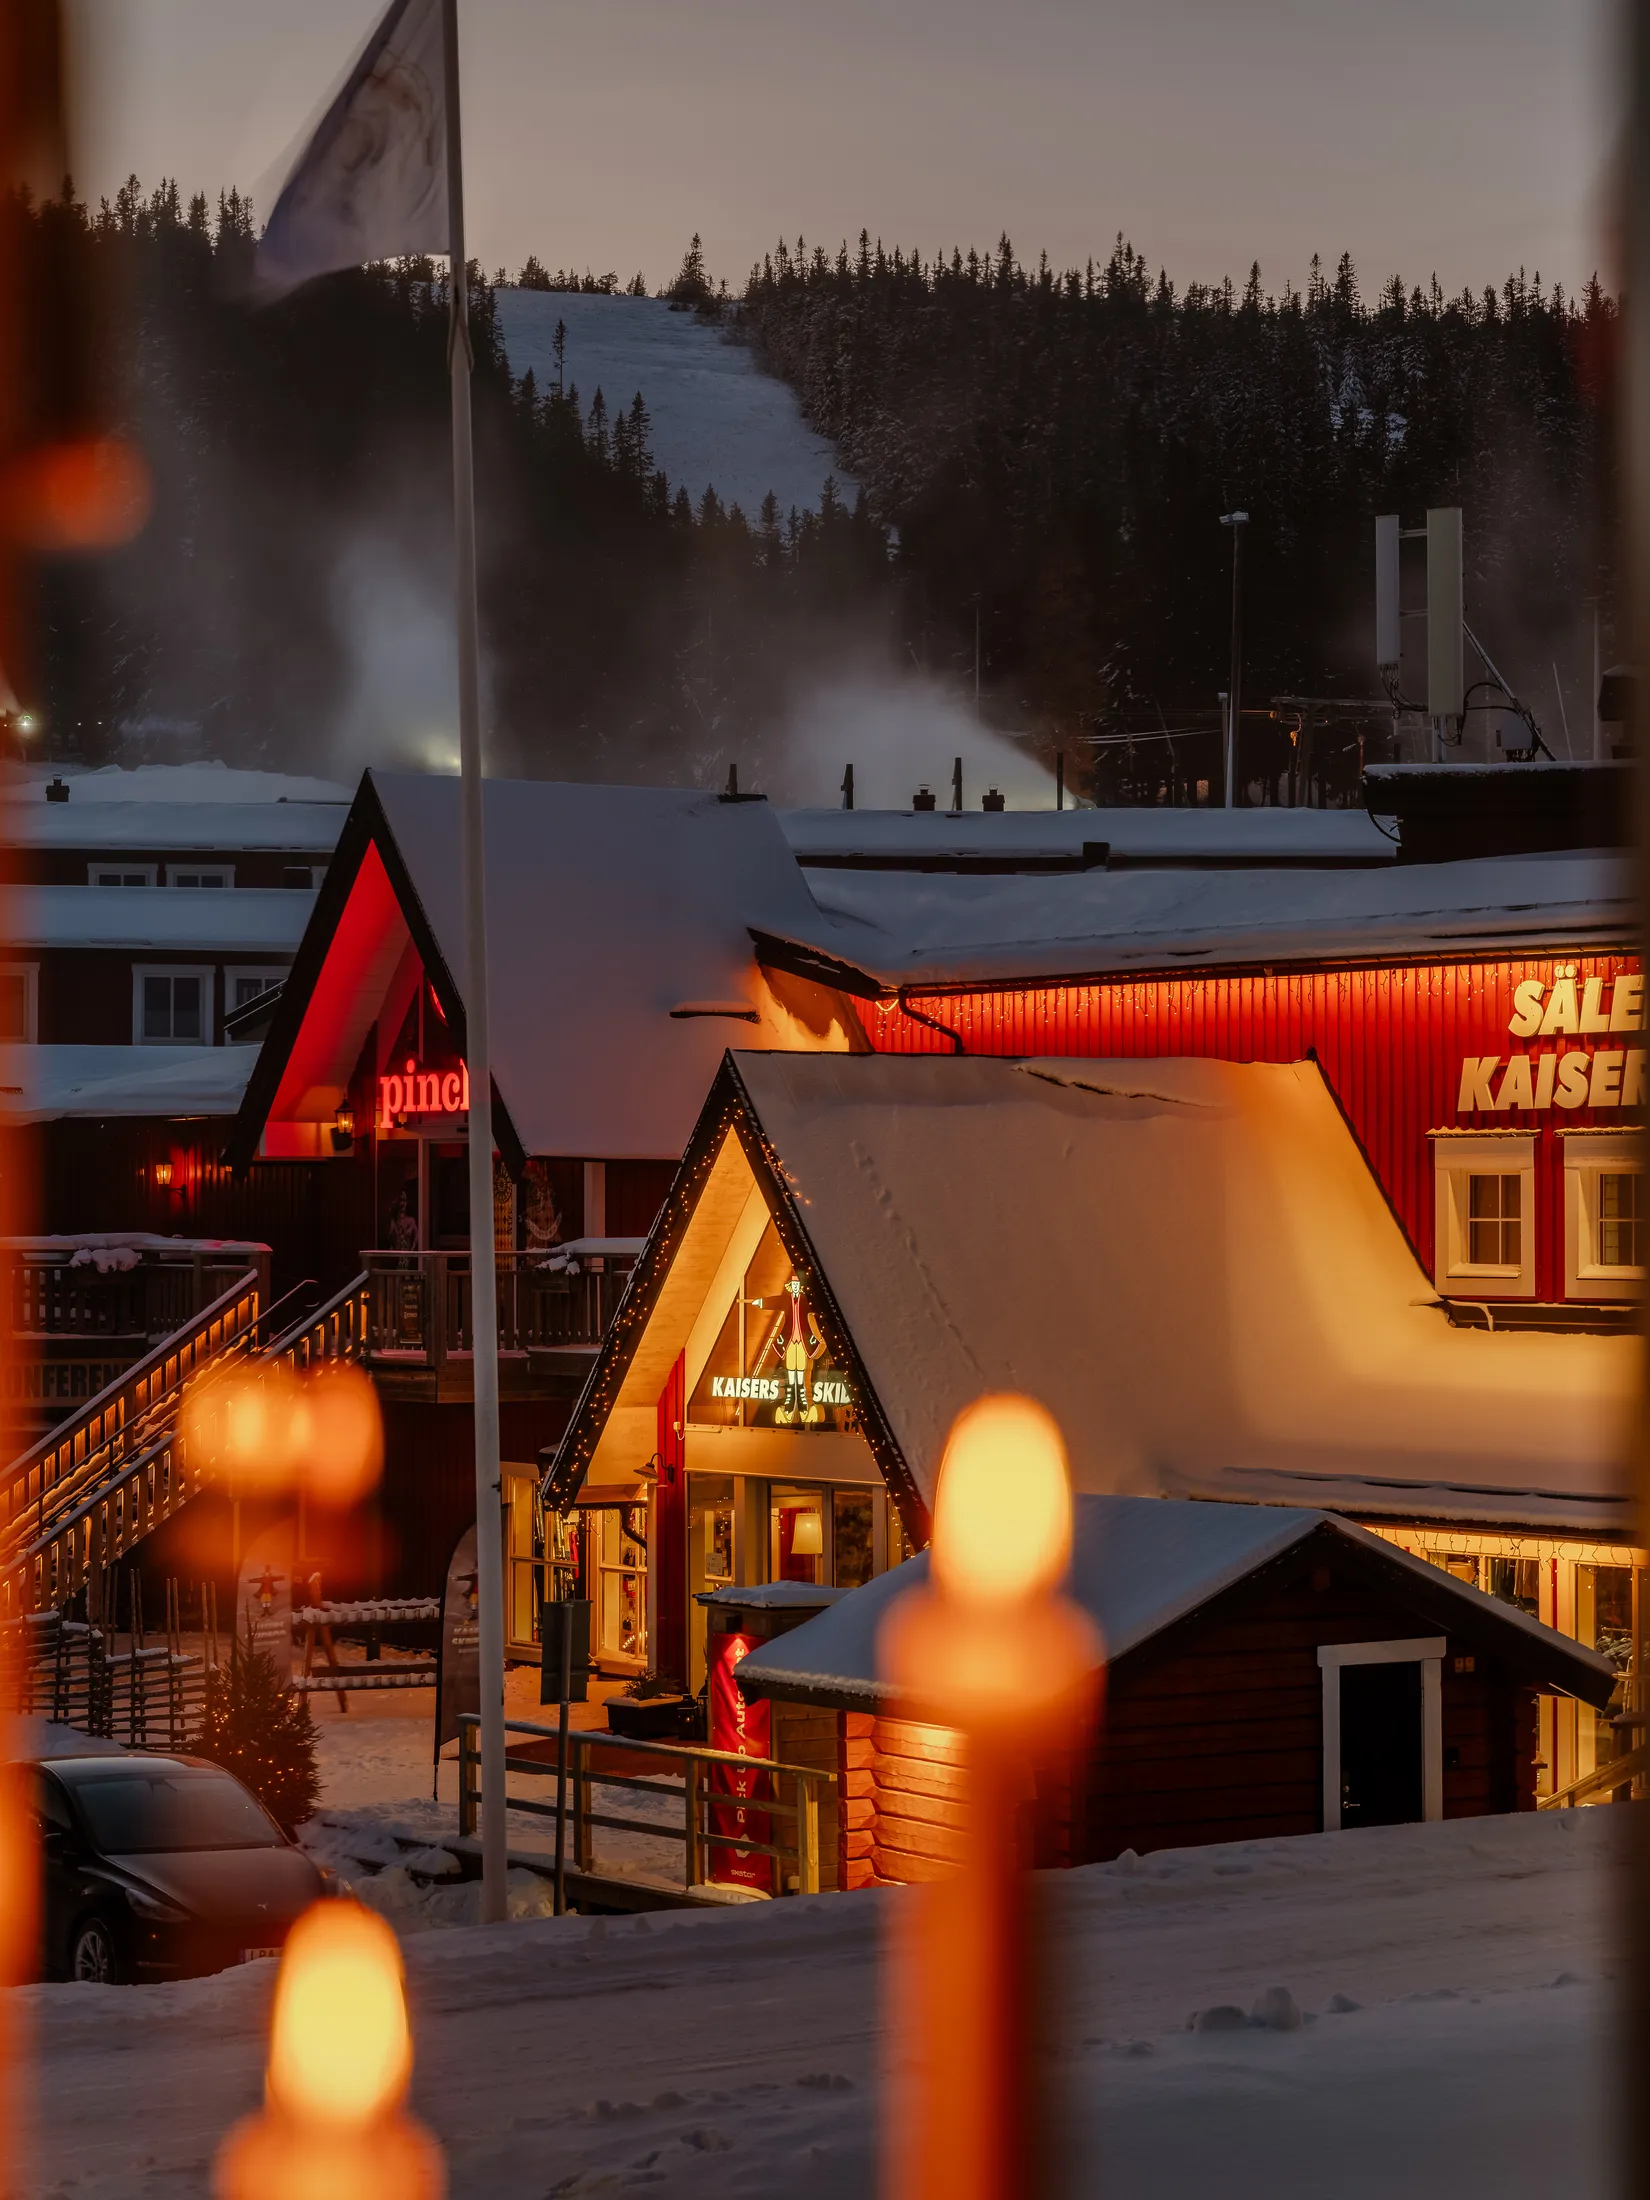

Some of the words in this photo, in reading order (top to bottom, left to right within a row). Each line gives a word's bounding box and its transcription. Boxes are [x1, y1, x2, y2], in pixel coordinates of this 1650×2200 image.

[1508, 964, 1647, 1037] SÄLE
[711, 1376, 780, 1400] KAISERS
[735, 1648, 746, 1740] Autot
